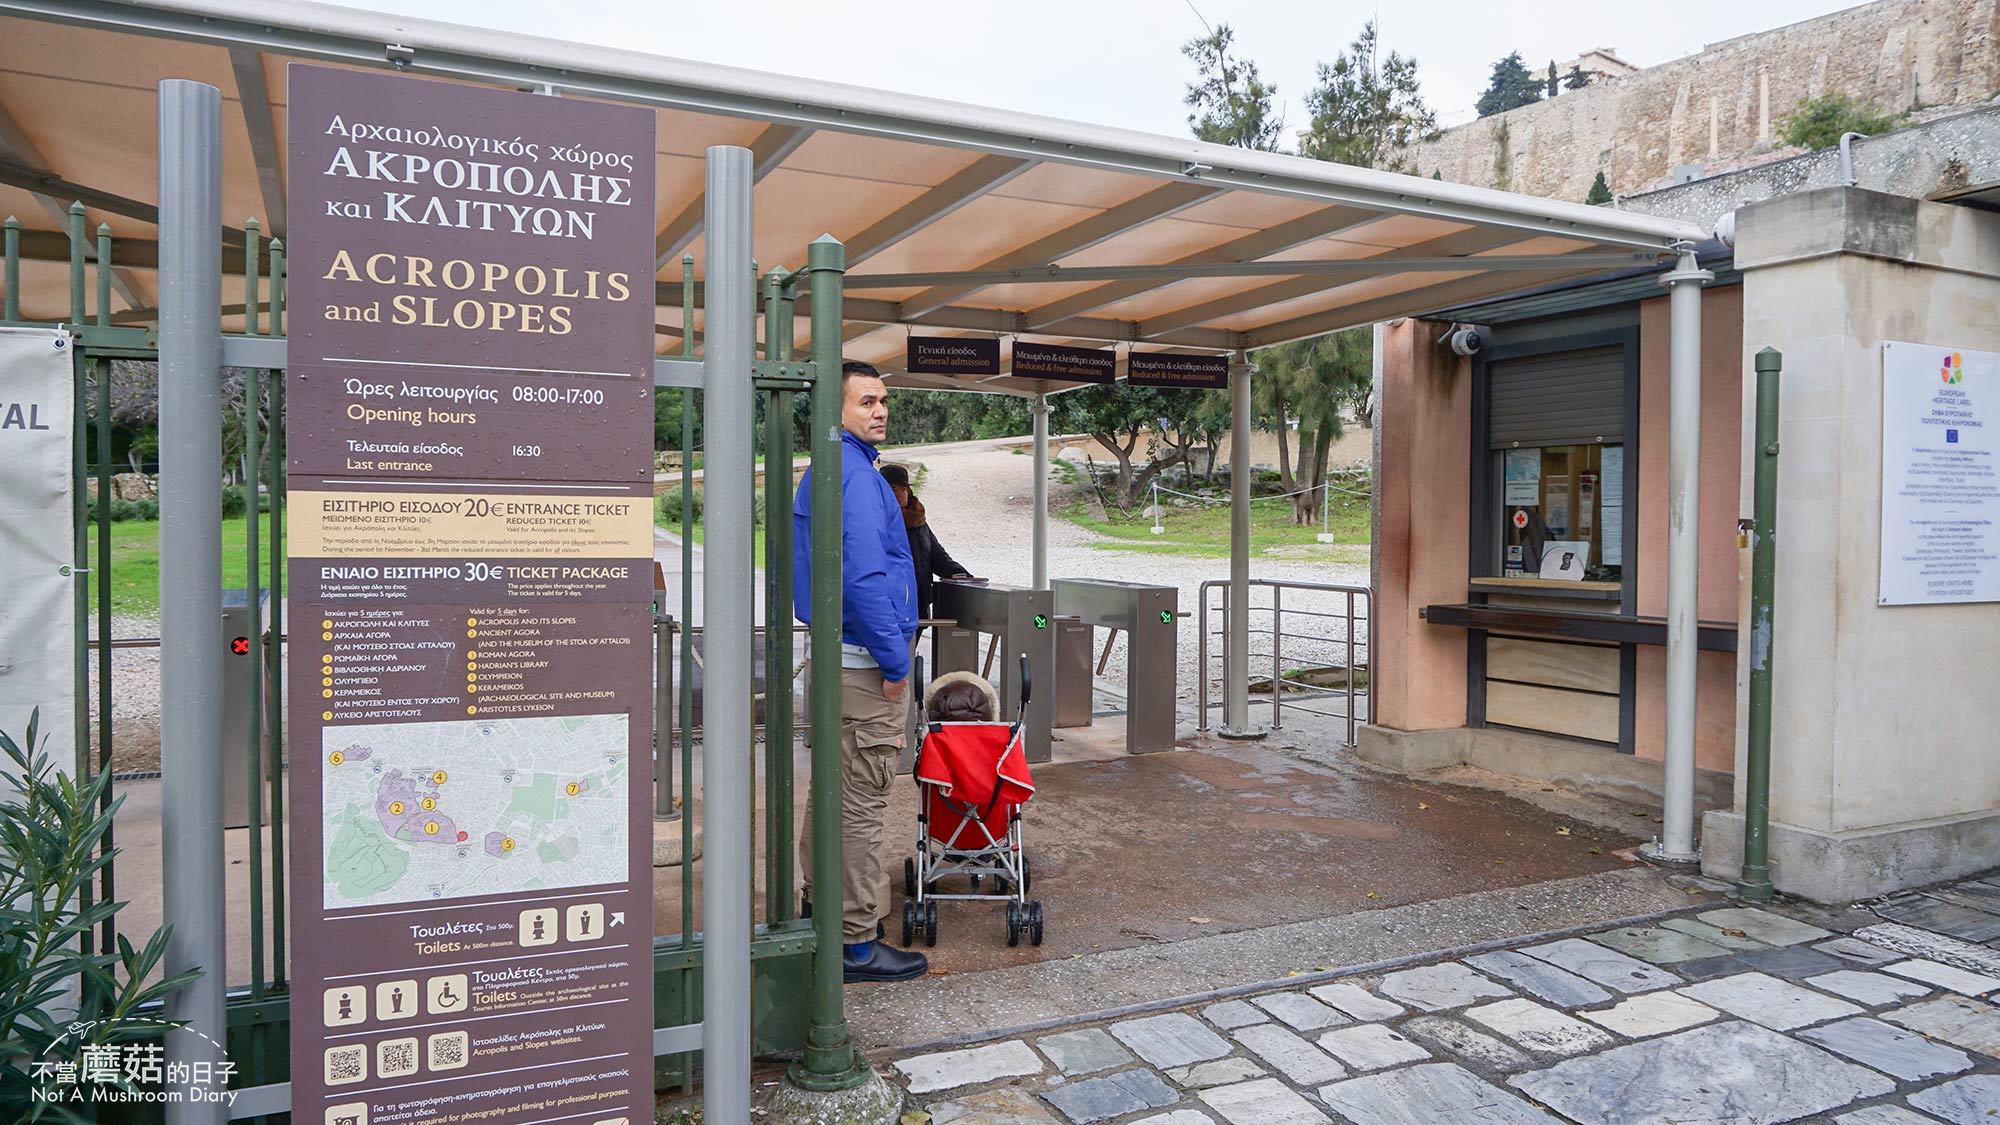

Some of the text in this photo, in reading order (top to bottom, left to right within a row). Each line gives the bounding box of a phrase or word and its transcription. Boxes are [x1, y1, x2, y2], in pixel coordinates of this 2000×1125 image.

[325, 115, 633, 173] Αρχαιολογικός χώρος
[323, 146, 632, 206] ΑΚΡΟΠΟΛΗΣ
[325, 192, 596, 240] και ΚΛΙΤΥΩΝ
[322, 249, 631, 301] ACROPOLIS
[324, 295, 573, 335] and SLOPES
[918, 345, 946, 355] Γενική
[918, 357, 990, 366] General admission
[1016, 361, 1045, 371] Reduced
[1053, 365, 1067, 373] free
[1069, 366, 1102, 376] admission
[344, 378, 604, 405] Ώρες λειτουργίας 08:00-17:00
[0, 403, 49, 430] AL
[347, 404, 476, 426] Opening hours
[347, 440, 541, 457] Τελευταία είσοδος 16:30
[347, 458, 432, 471] Last entrance
[323, 498, 630, 517] ΕΙΣΙΤΗΡΙΟ ΕΙΣΟΔΟΥ 20€ ENTRANCE TICKET
[321, 562, 628, 581] ΕΝΙΑΙΟ ΕΙΣΙΤΗΡΙΟ 30€ TICKET PACKAGE
[479, 618, 519, 626] ACROPOLIS
[479, 662, 518, 670] HADRIAN'S
[478, 694, 547, 703] (ARCHAEOLOGICAL
[583, 691, 615, 699] MUSEUM)
[365, 710, 422, 718] ΑΡΙΣΤΟΤΕΛΟΥΣ
[478, 705, 522, 713] ARISTOTLE'S
[410, 922, 483, 938] Τουαλέτες
[415, 941, 460, 954] Toilets
[472, 967, 543, 983] Τουαλέτες
[472, 991, 516, 1004] Toilets
[558, 985, 597, 994] archaeological
[494, 1000, 526, 1010] Information
[473, 1034, 518, 1046] Ιστοσελίδες
[520, 1029, 561, 1040] Ακρόπολης
[473, 1046, 508, 1056] Acropolis
[525, 1040, 548, 1050] Slopes
[417, 1115, 447, 1125] required
[461, 1106, 506, 1122] photography
[507, 1104, 520, 1112] and
[522, 1100, 544, 1111] filming
[557, 1093, 597, 1106] professional
